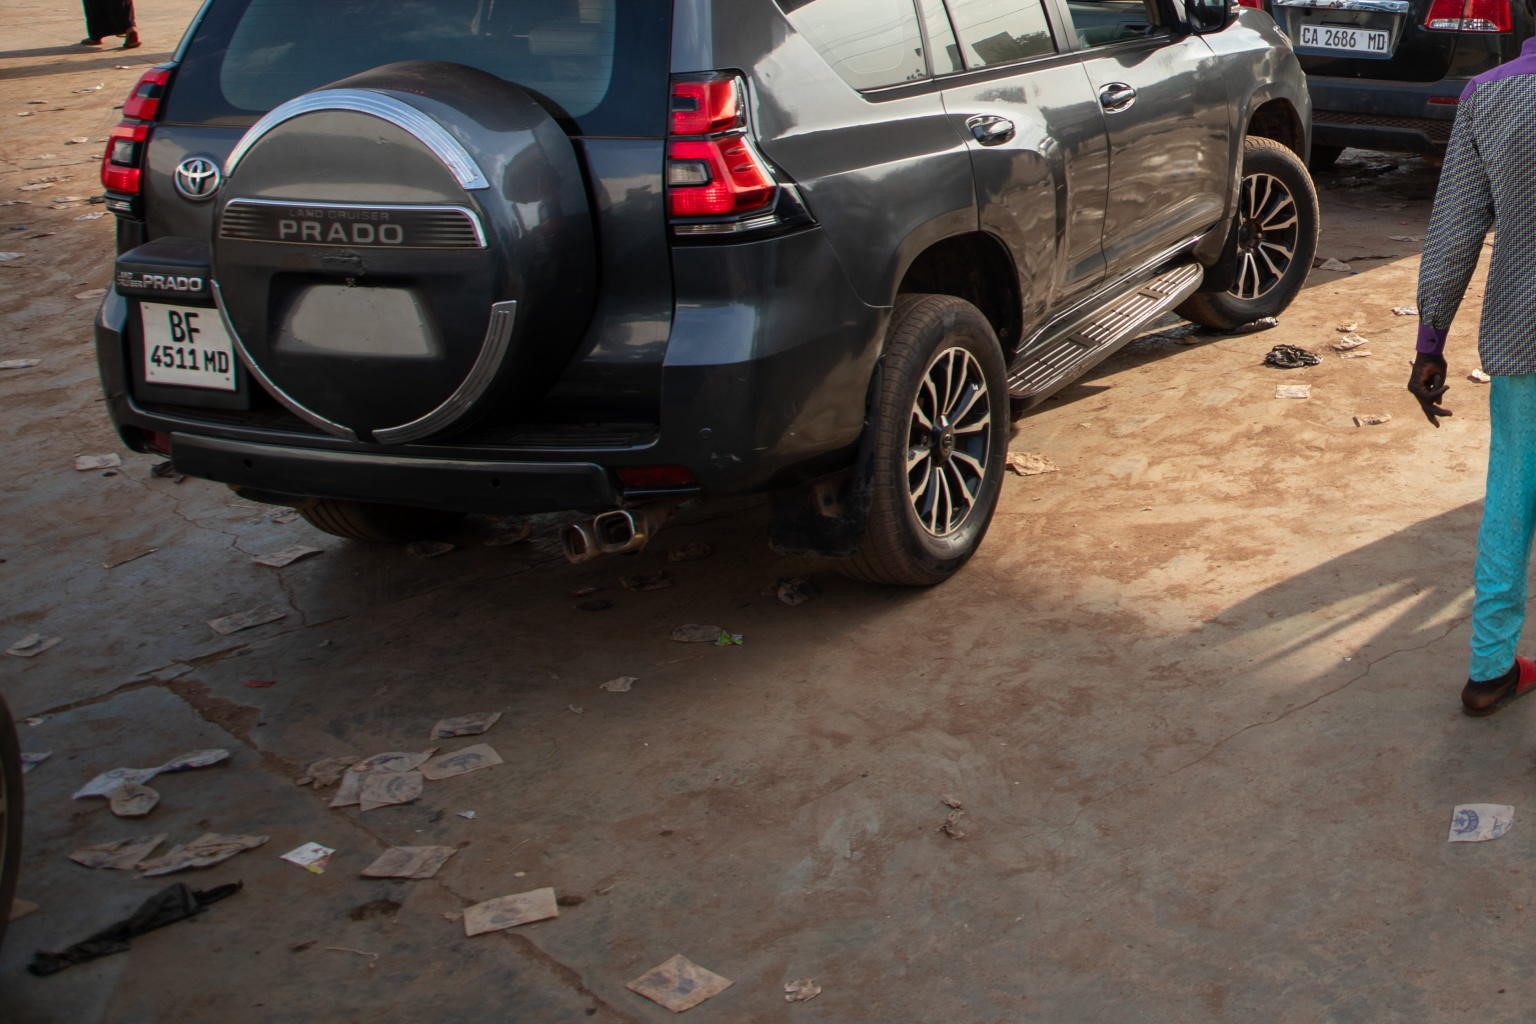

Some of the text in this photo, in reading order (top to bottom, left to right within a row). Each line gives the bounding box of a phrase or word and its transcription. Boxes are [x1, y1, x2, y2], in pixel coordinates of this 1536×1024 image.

[1302, 27, 1386, 51] CA 2686 MD
[289, 208, 390, 221] LAND CRUISER
[278, 219, 404, 244] PRADO
[142, 274, 202, 292] PRADO
[168, 309, 200, 344] BF
[151, 344, 229, 374] 4511 MD
